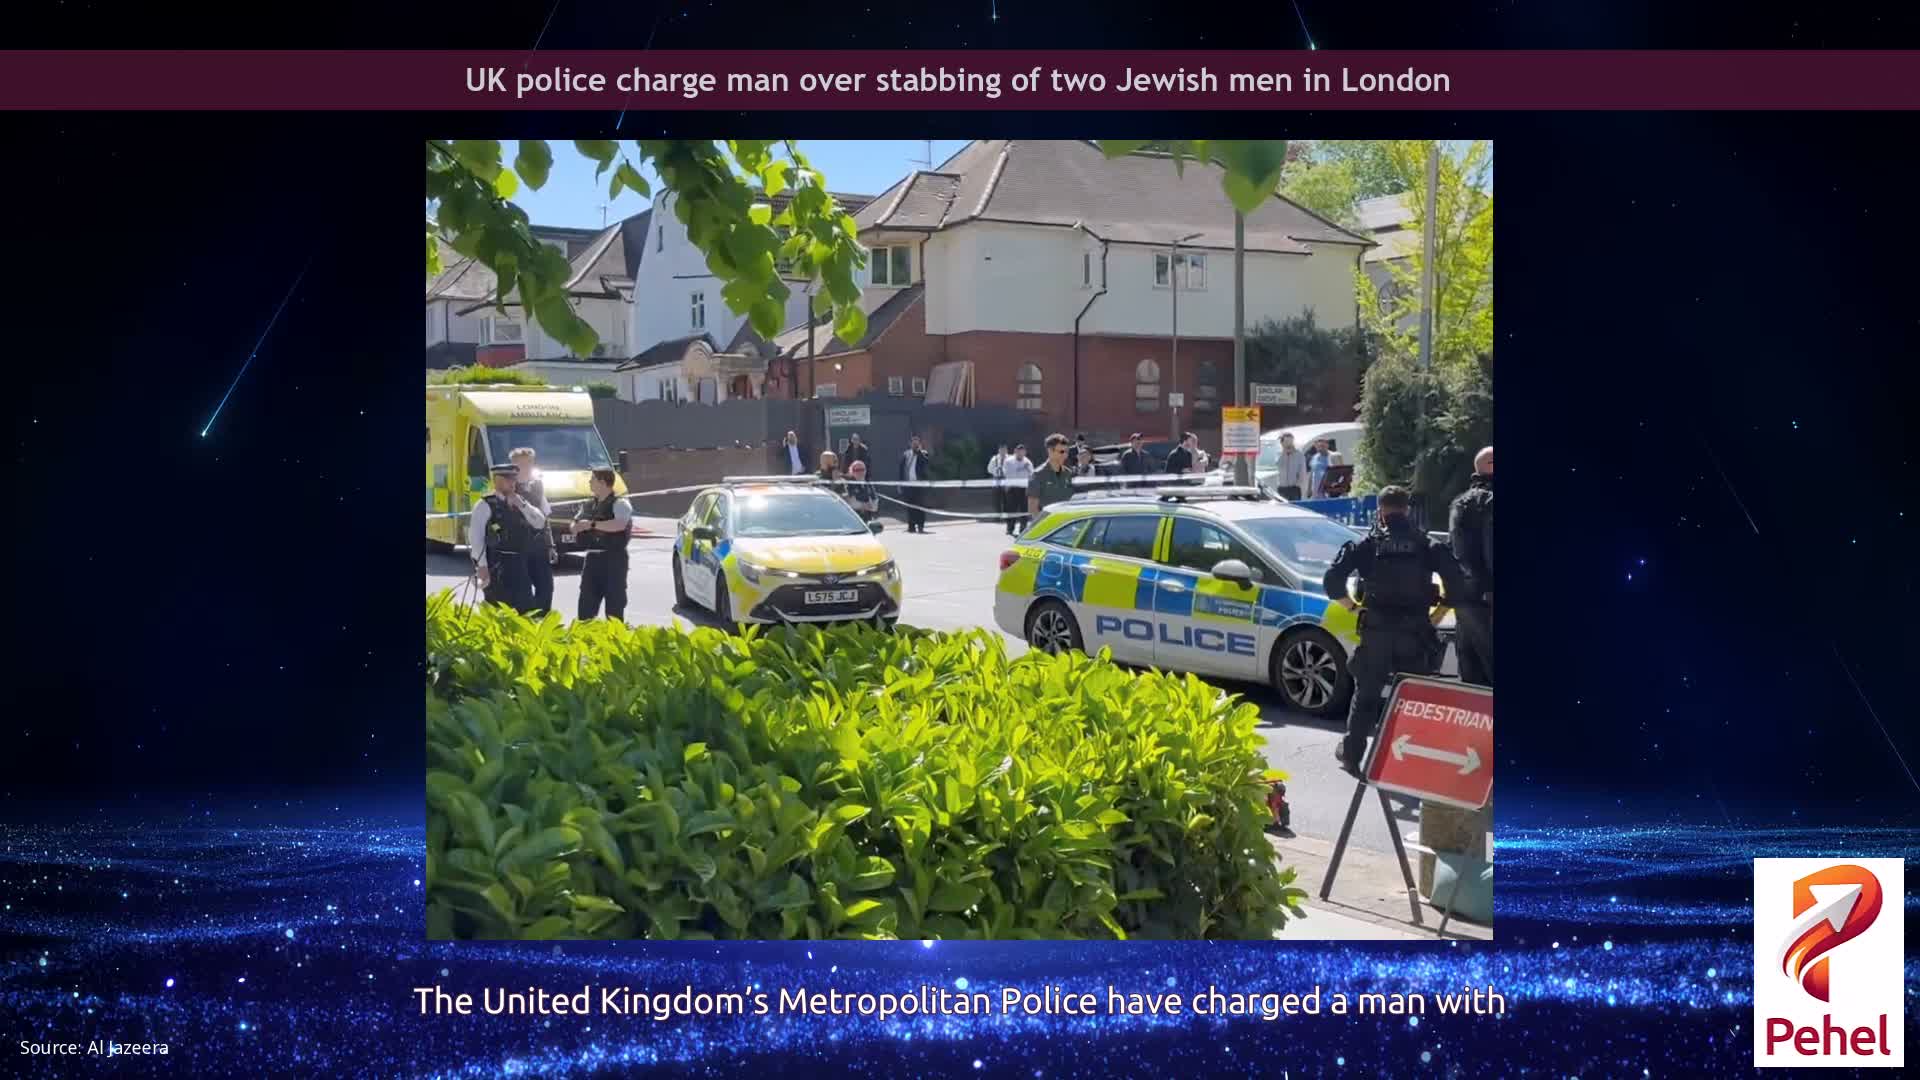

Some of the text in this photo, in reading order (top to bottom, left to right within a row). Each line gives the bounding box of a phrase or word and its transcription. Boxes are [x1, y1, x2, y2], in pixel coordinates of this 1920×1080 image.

[808, 592, 834, 602] LS75
[1096, 614, 1256, 656] POLICE
[1394, 699, 1493, 731] PEDESTRIAN
